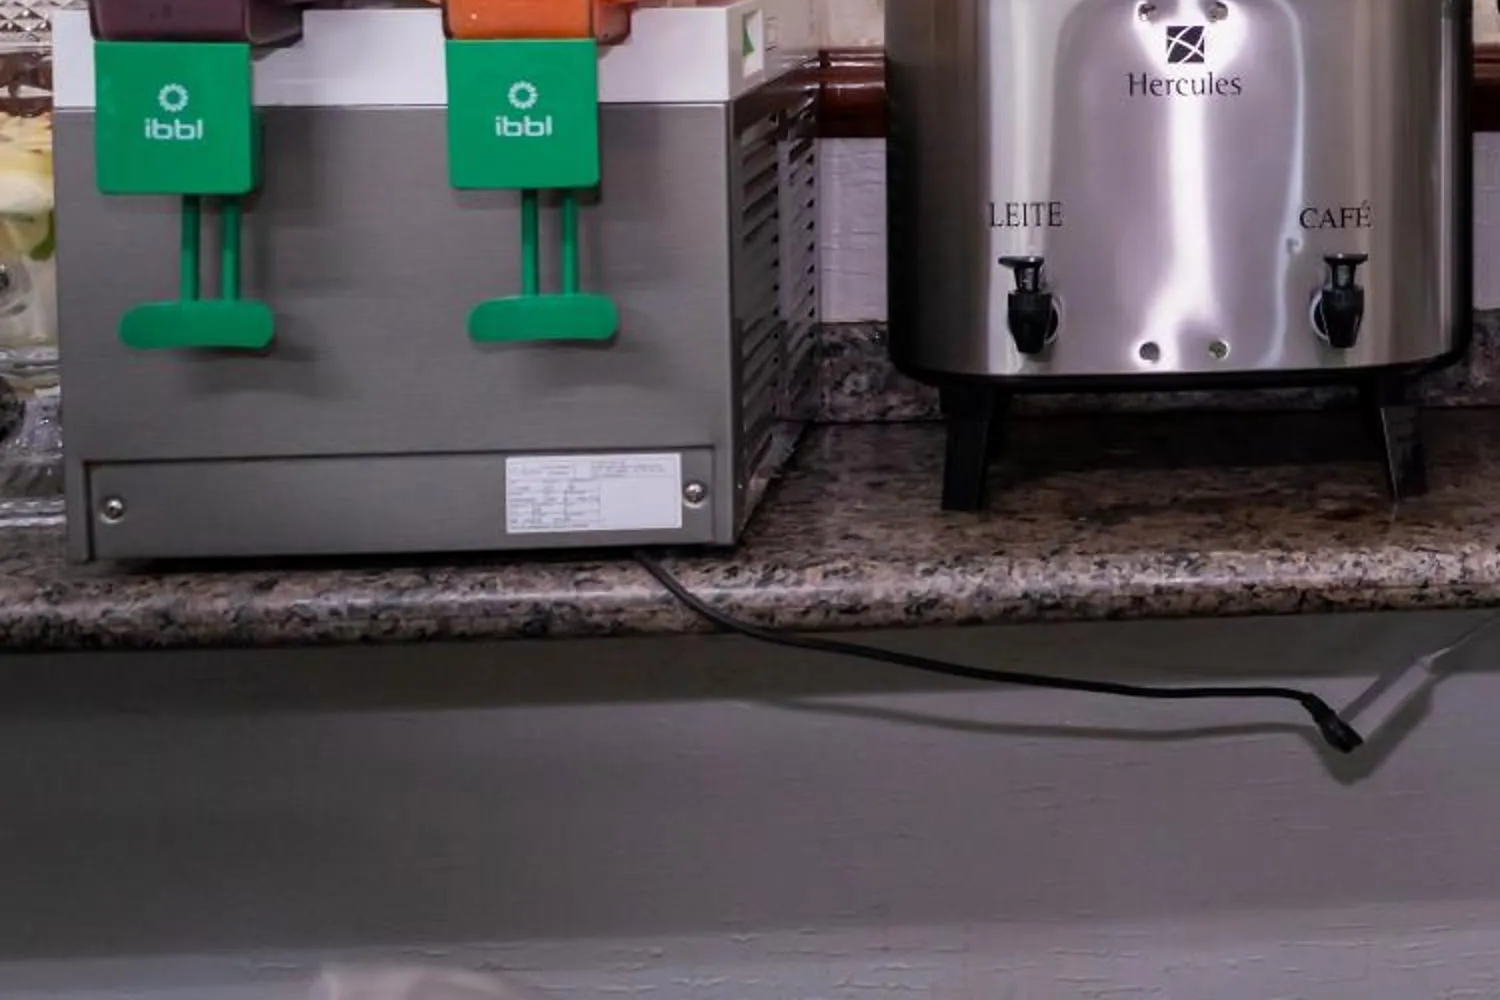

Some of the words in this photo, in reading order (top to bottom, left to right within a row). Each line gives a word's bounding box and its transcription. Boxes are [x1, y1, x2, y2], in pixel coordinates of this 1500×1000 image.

[1127, 72, 1243, 98] Hercules
[143, 118, 204, 141] ibbl
[494, 114, 553, 137] ibbl
[988, 201, 1064, 228] LEITE
[1299, 200, 1372, 230] CAFÉ
